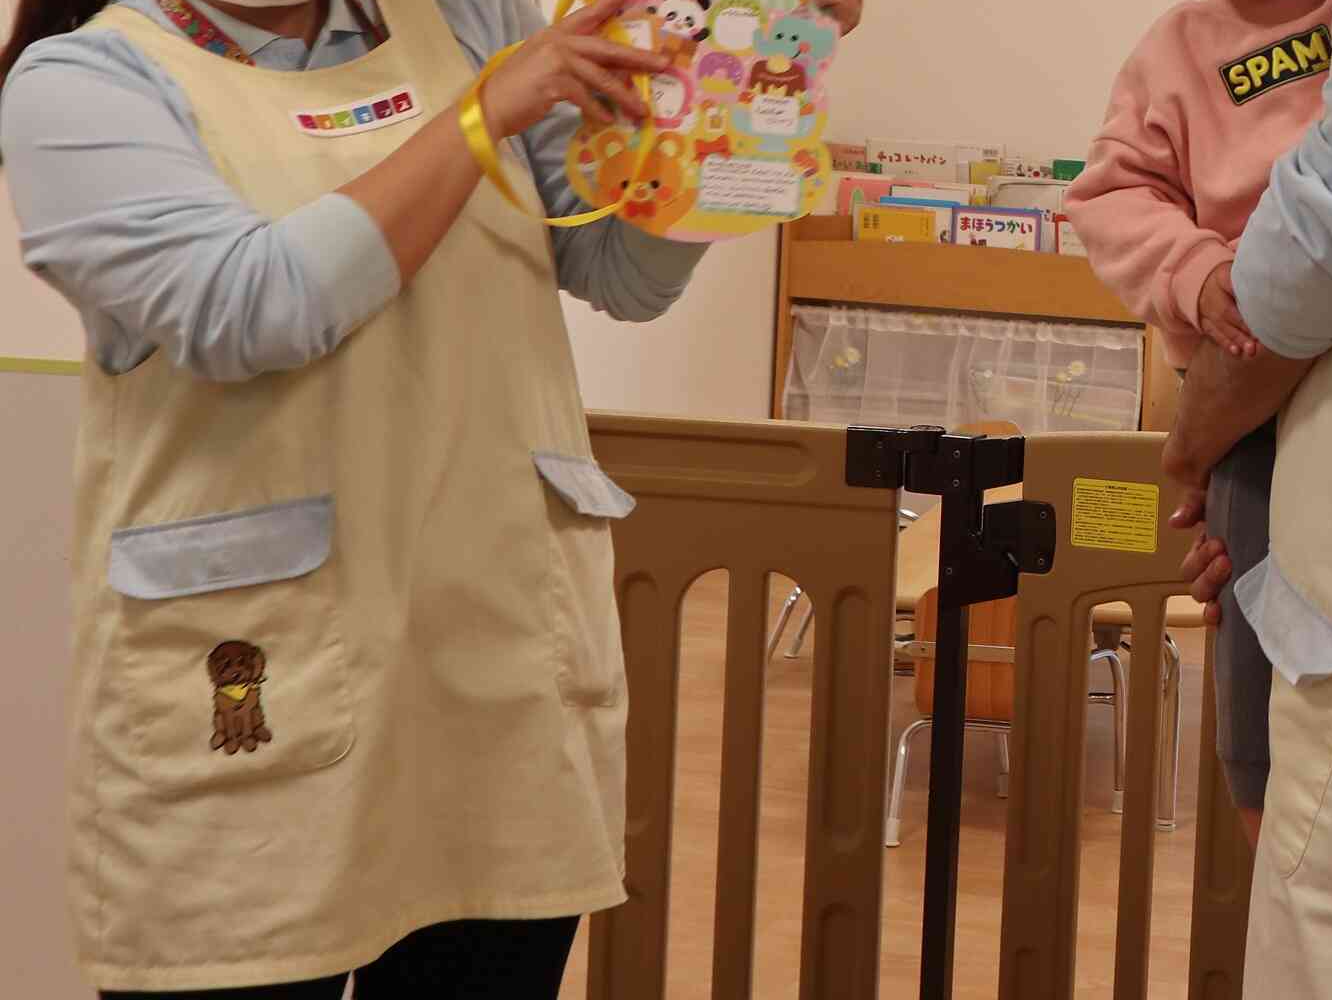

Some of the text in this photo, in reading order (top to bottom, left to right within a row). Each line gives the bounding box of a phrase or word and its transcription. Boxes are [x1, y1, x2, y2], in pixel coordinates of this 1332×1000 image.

[1228, 31, 1329, 96] SPAM
[877, 150, 947, 165] チョコレートパン
[959, 216, 1033, 234] まほうつかい
